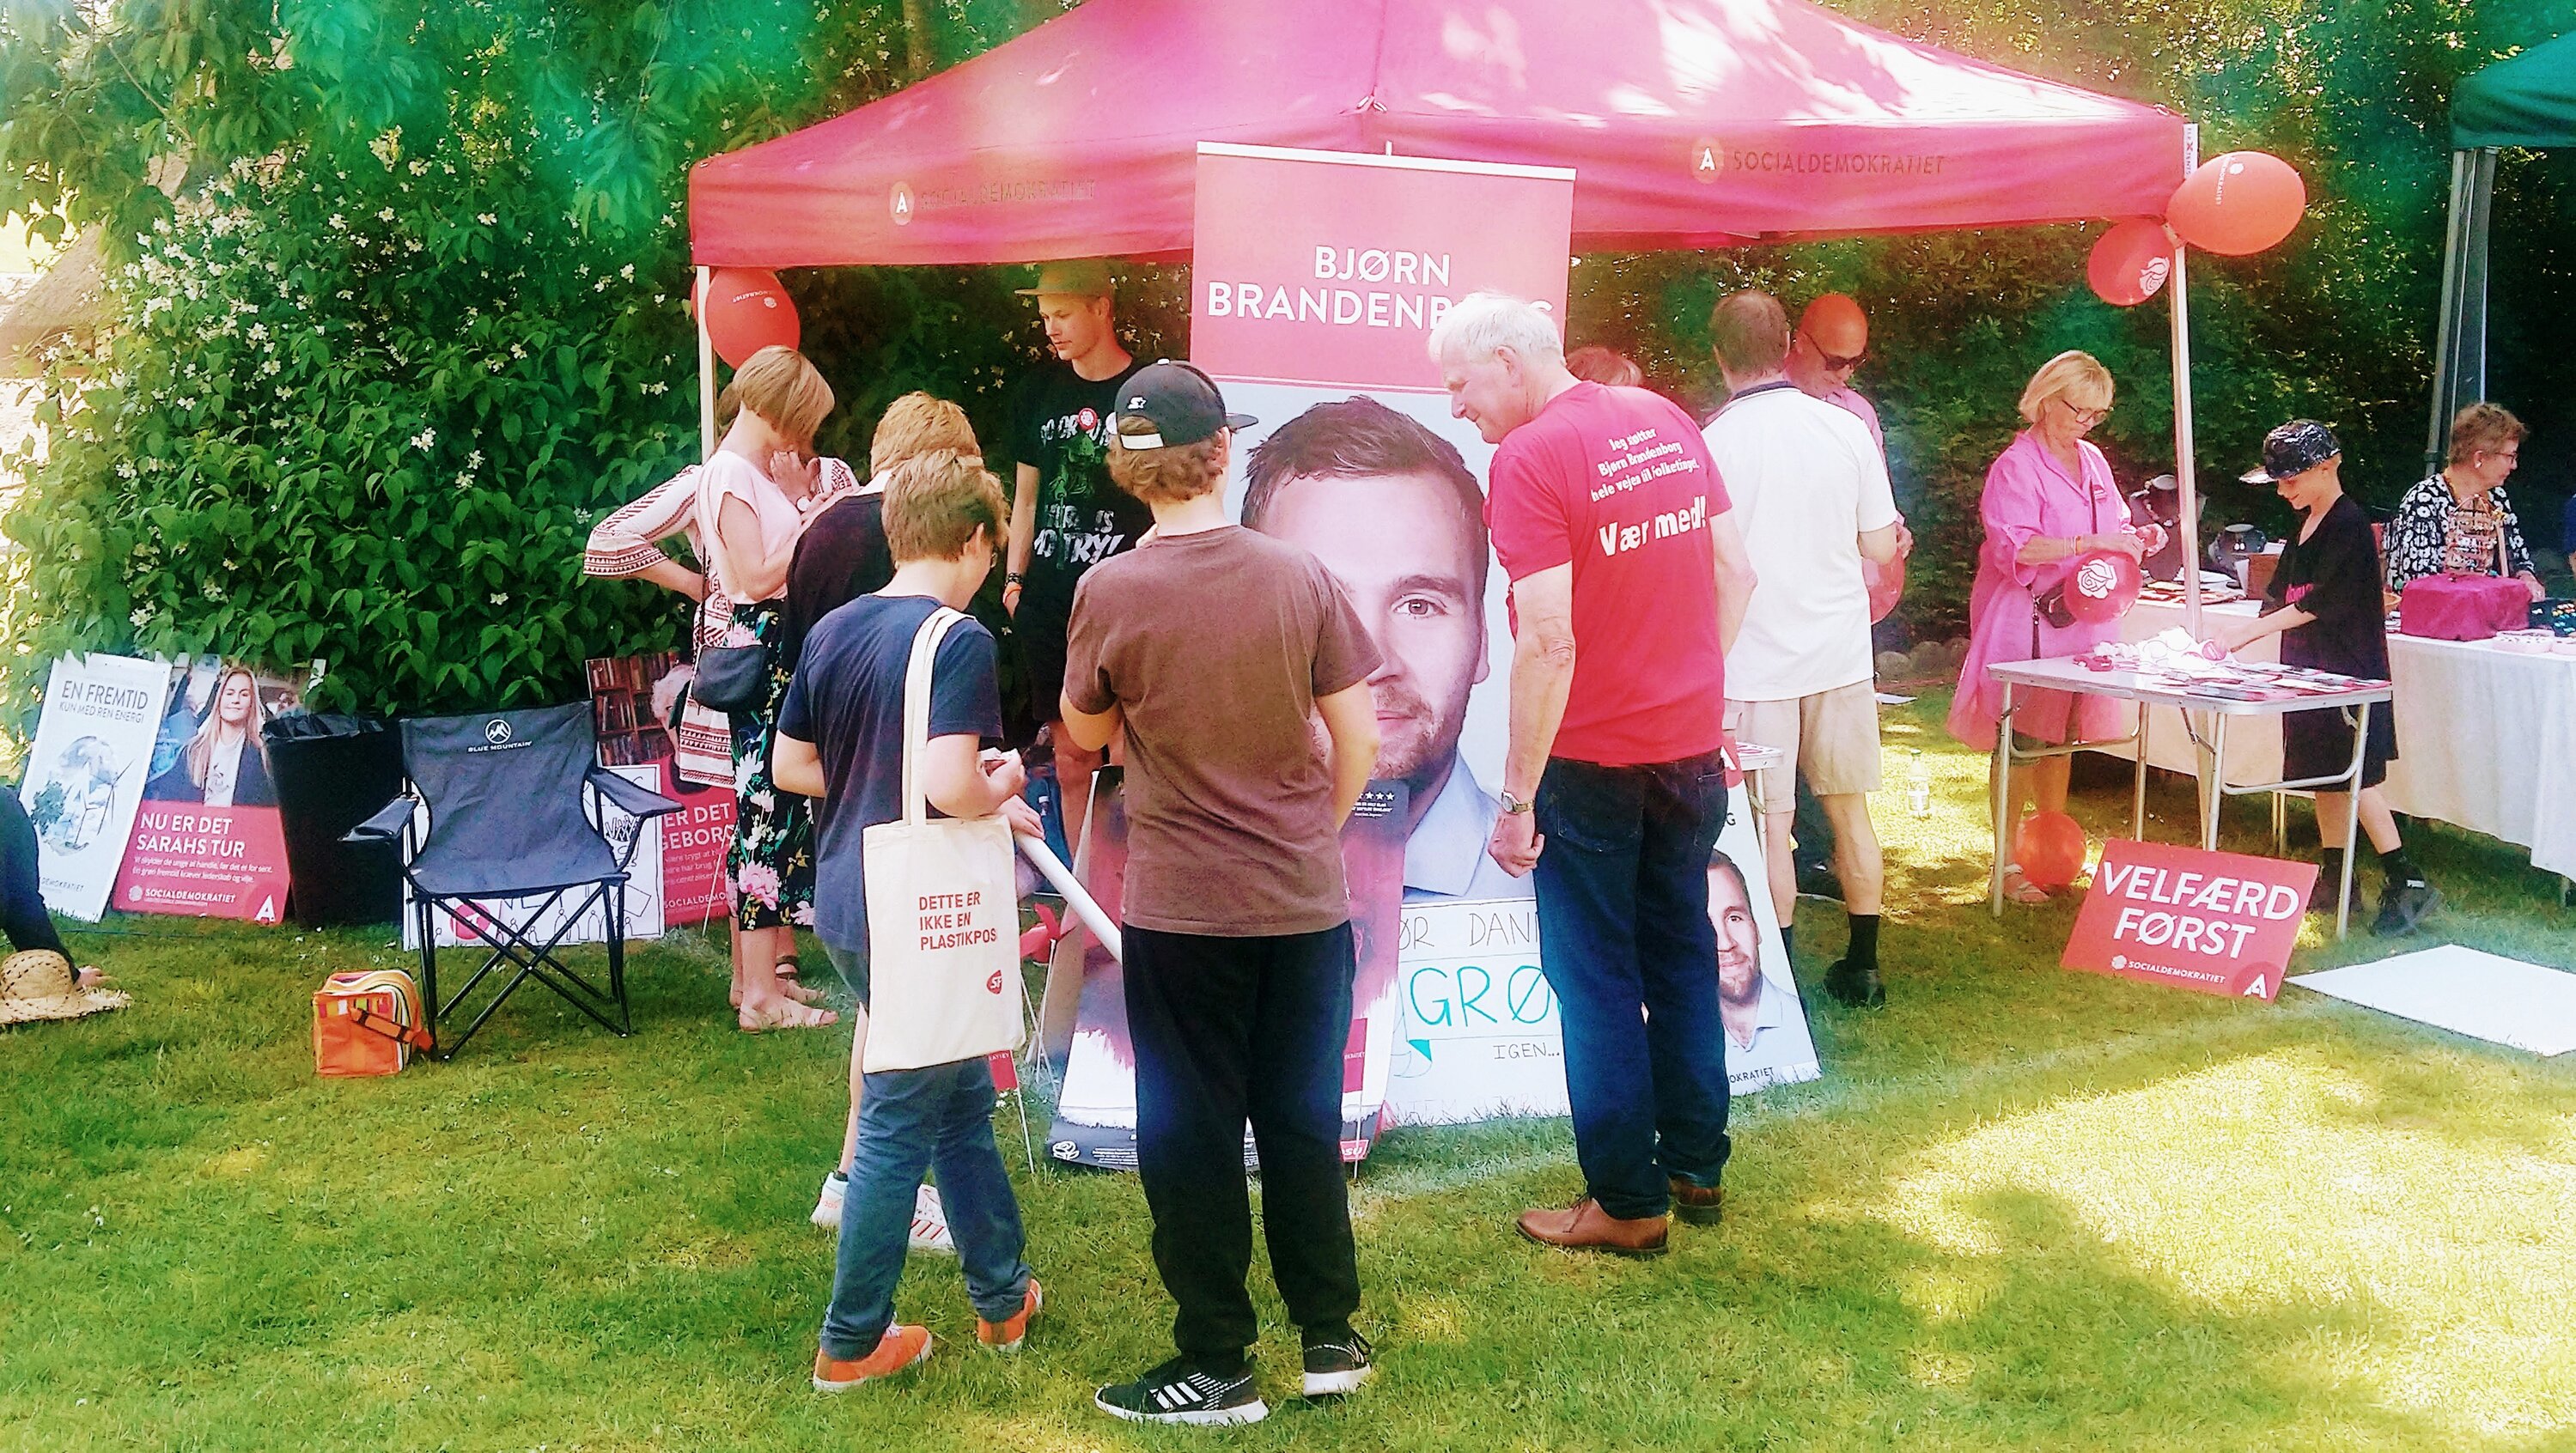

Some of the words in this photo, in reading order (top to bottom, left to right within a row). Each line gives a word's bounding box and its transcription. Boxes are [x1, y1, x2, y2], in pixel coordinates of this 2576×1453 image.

[1700, 148, 1716, 171] A
[1733, 150, 1945, 174] SOCIALDEMOKRATIET
[895, 192, 909, 213] A
[1314, 246, 1450, 287] BJØRN
[1208, 282, 1463, 330] BRANDENB
[1609, 438, 1629, 452] Jeg
[1598, 459, 1629, 477] Bjørn
[1626, 441, 1684, 466] Brandenborg
[1591, 483, 1616, 502] hele
[1616, 474, 1642, 491] vejen
[1641, 468, 1653, 483] til
[1599, 521, 1649, 556] Vær
[1654, 495, 1707, 539] med!
[62, 680, 83, 699] EN
[86, 684, 149, 710] FREMTID
[59, 702, 76, 712] KUN
[77, 704, 96, 716] MED
[97, 707, 114, 719] REN
[115, 709, 144, 723] ENERGI
[490, 741, 533, 751] MOUNTAIN
[140, 812, 167, 831] NU
[171, 814, 195, 834] ER
[198, 817, 233, 835] DET
[663, 810, 689, 828] ER
[694, 803, 730, 824] DET
[137, 834, 207, 855] SARAHS
[211, 839, 246, 858] TUR
[919, 894, 963, 910] DETTE
[967, 891, 981, 906] ER
[2104, 861, 2299, 921] VELFÆRD
[145, 888, 236, 903] SOCIALDEMOKRATIET
[254, 894, 276, 922] A
[920, 915, 952, 930] IKKE
[957, 912, 971, 927] EN
[1469, 912, 1540, 946] DAN
[2113, 907, 2256, 959] FØRST
[921, 927, 996, 951] PLASTIKPOS
[990, 976, 1002, 989] SF
[2128, 960, 2226, 984] SOCIALDEMOKRATIET
[2244, 973, 2268, 999] A
[1410, 965, 1556, 1027] GRØ
[1729, 1067, 1775, 1084] OKRATIET
